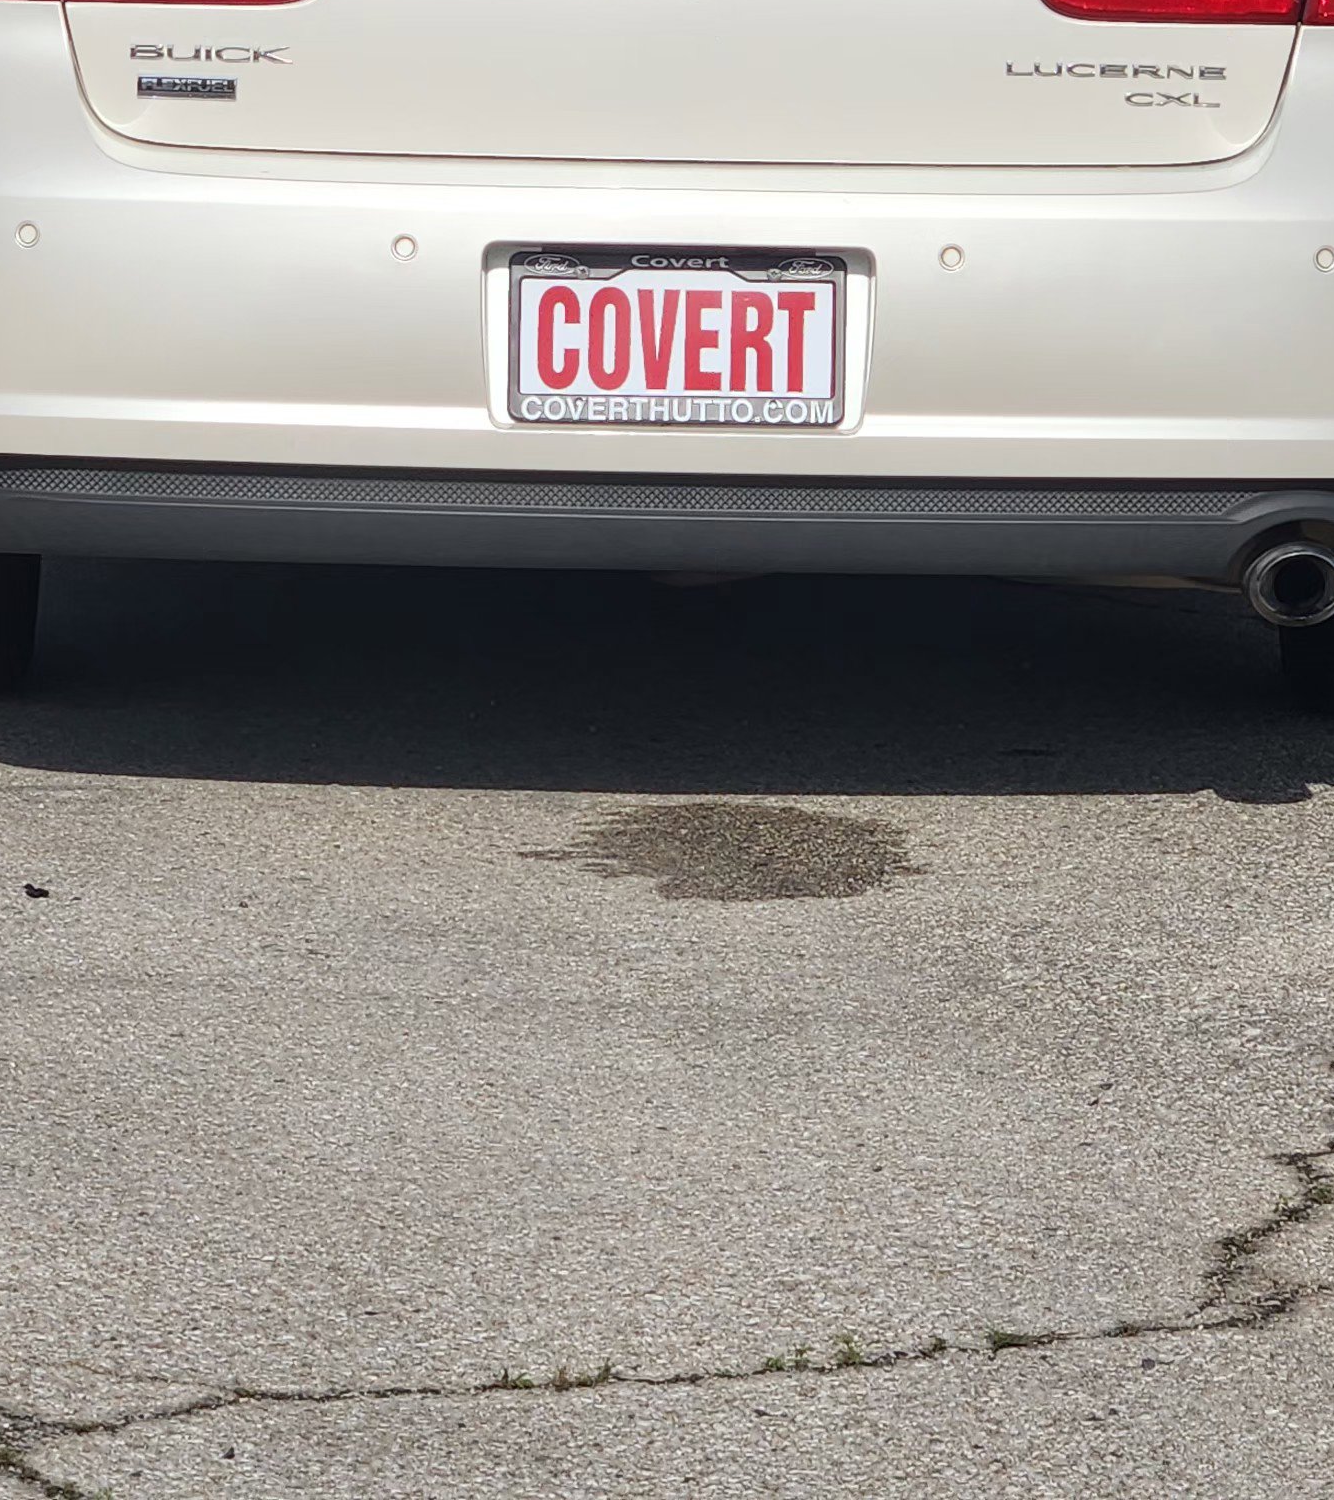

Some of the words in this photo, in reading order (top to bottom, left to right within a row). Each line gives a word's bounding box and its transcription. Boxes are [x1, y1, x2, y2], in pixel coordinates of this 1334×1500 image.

[129, 44, 294, 65] BUICK
[1005, 60, 1228, 81] LUCERNE
[140, 77, 236, 93] FLEXFUEL
[1123, 91, 1221, 109] CXL
[630, 254, 731, 270] Covert
[537, 285, 816, 393] COVERT
[520, 396, 835, 425] COVERTHUTTO.COM
